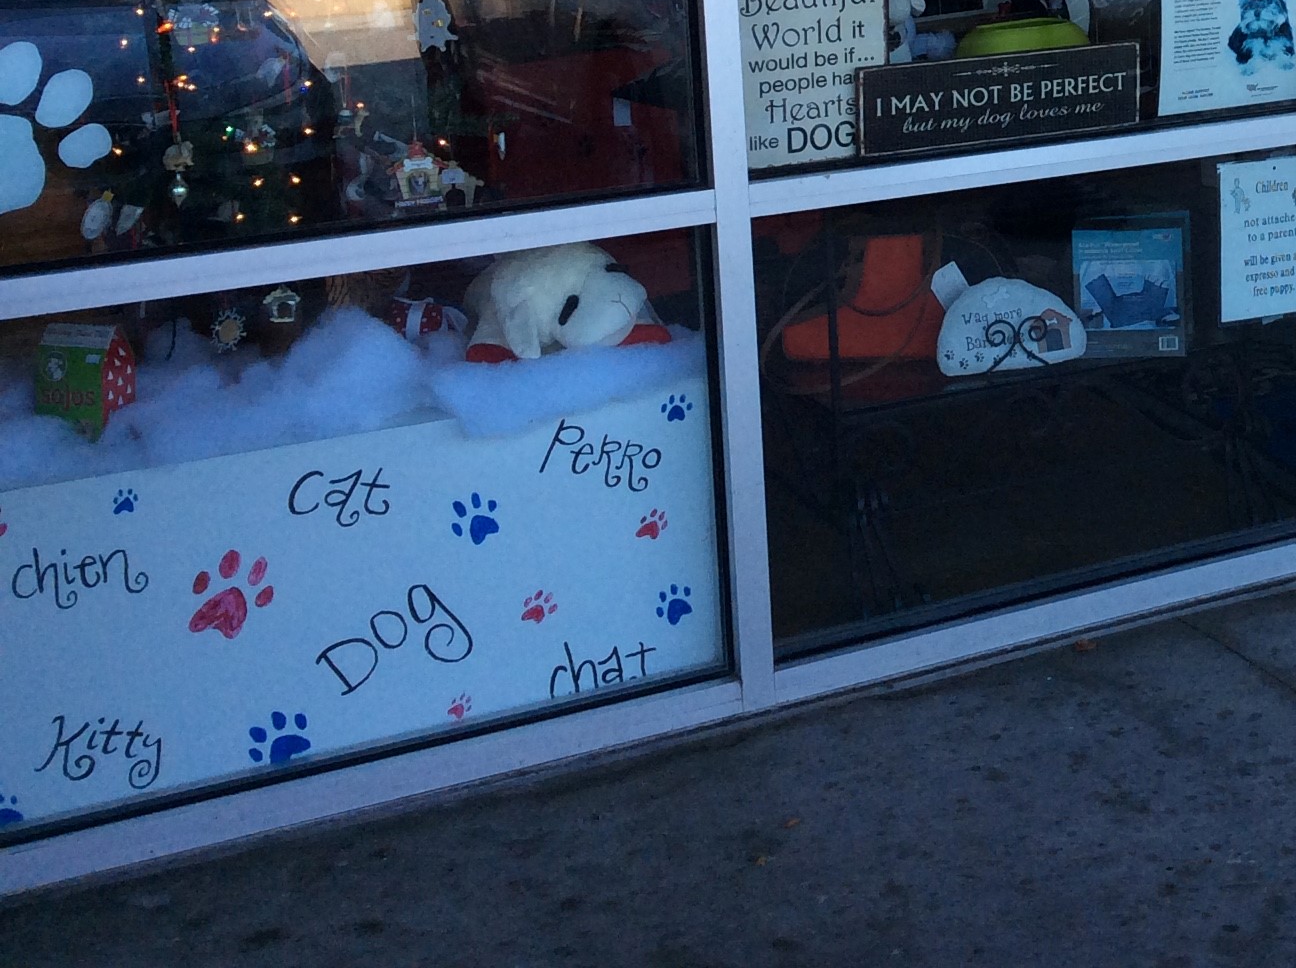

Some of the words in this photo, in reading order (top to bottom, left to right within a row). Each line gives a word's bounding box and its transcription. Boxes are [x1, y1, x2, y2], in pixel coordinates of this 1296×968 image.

[751, 15, 842, 51] World
[852, 20, 865, 39] it
[749, 51, 808, 73] would
[814, 50, 838, 67] be
[844, 47, 875, 63] if...
[759, 72, 827, 98] people
[876, 98, 882, 117] I
[891, 92, 944, 115] MAY
[952, 85, 1003, 109] NOT
[1011, 83, 1034, 102] BE
[1041, 72, 1127, 99] PERFECT
[764, 94, 857, 125] Hearts
[903, 115, 937, 134] but
[941, 116, 974, 133] my
[977, 107, 1016, 129] dog
[1019, 103, 1072, 121] loves
[1074, 101, 1105, 114] me
[750, 135, 779, 151] like
[1255, 180, 1289, 194] Children
[1244, 218, 1259, 228] not
[1247, 233, 1257, 243] to
[1244, 255, 1258, 267] will
[1260, 254, 1269, 265] be
[1270, 252, 1291, 266] given
[1245, 270, 1278, 283] expresso
[1280, 266, 1295, 277] and
[1253, 286, 1268, 297] free
[1270, 283, 1296, 297] puppy.
[962, 312, 989, 330] Wag
[994, 308, 1022, 320] more
[34, 715, 162, 789] Kitty
